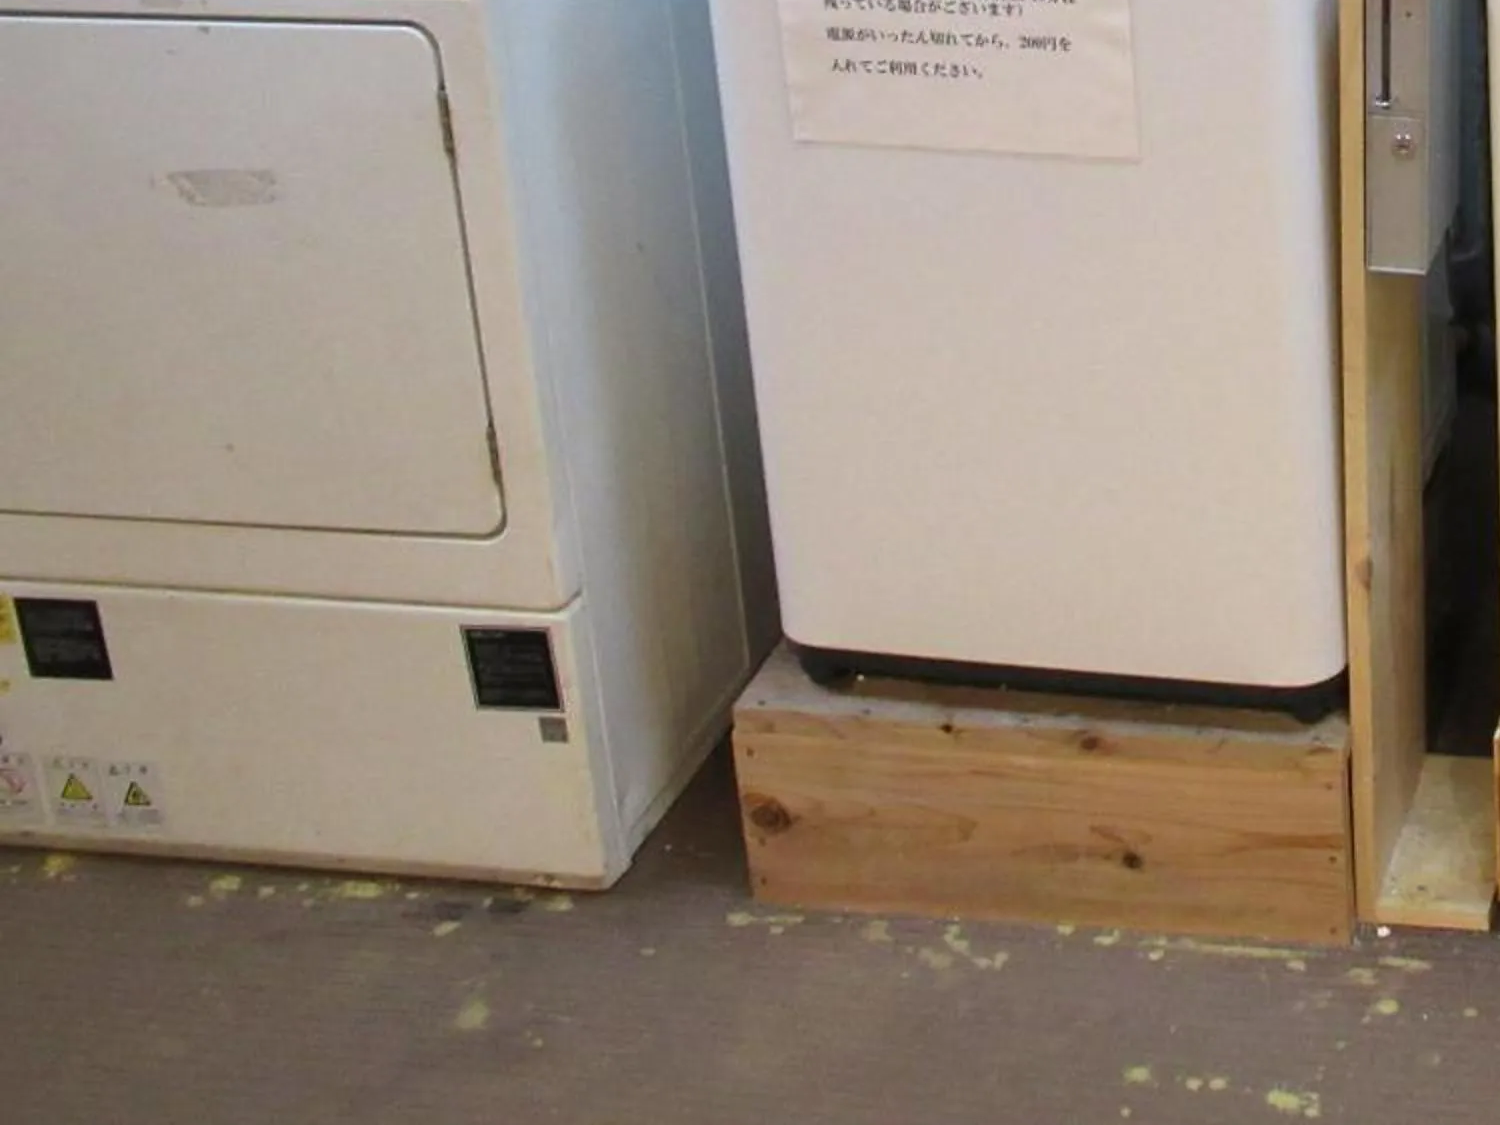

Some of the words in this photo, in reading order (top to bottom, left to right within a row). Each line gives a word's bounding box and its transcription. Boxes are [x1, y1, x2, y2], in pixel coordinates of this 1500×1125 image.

[825, 26, 1073, 53] 電源がいったん切れてから、200円を
[830, 57, 985, 80] 入れてご利用ください。
